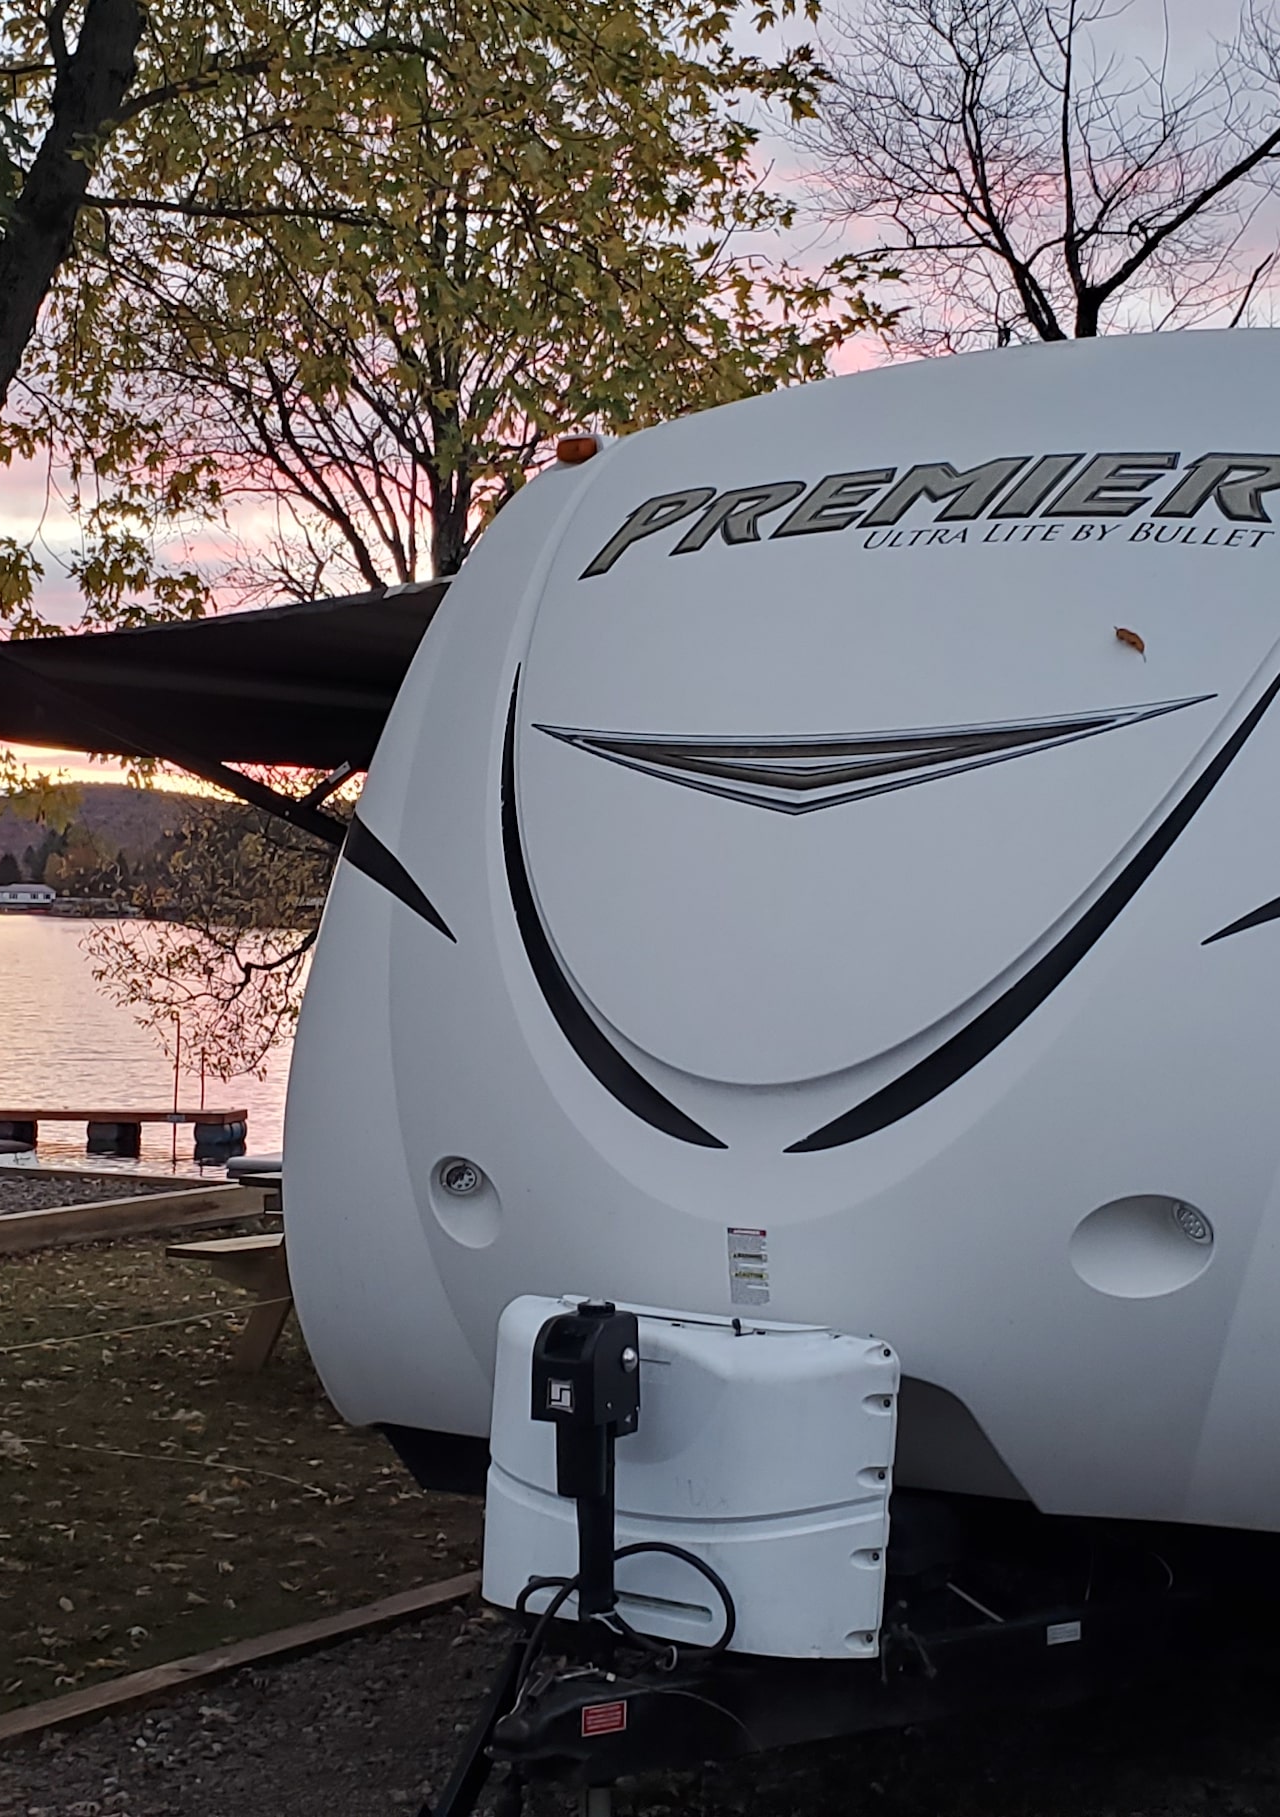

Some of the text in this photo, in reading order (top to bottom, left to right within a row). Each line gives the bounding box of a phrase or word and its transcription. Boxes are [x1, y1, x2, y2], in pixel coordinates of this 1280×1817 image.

[863, 522, 1276, 549] ULTRA LITE BY BULLET
